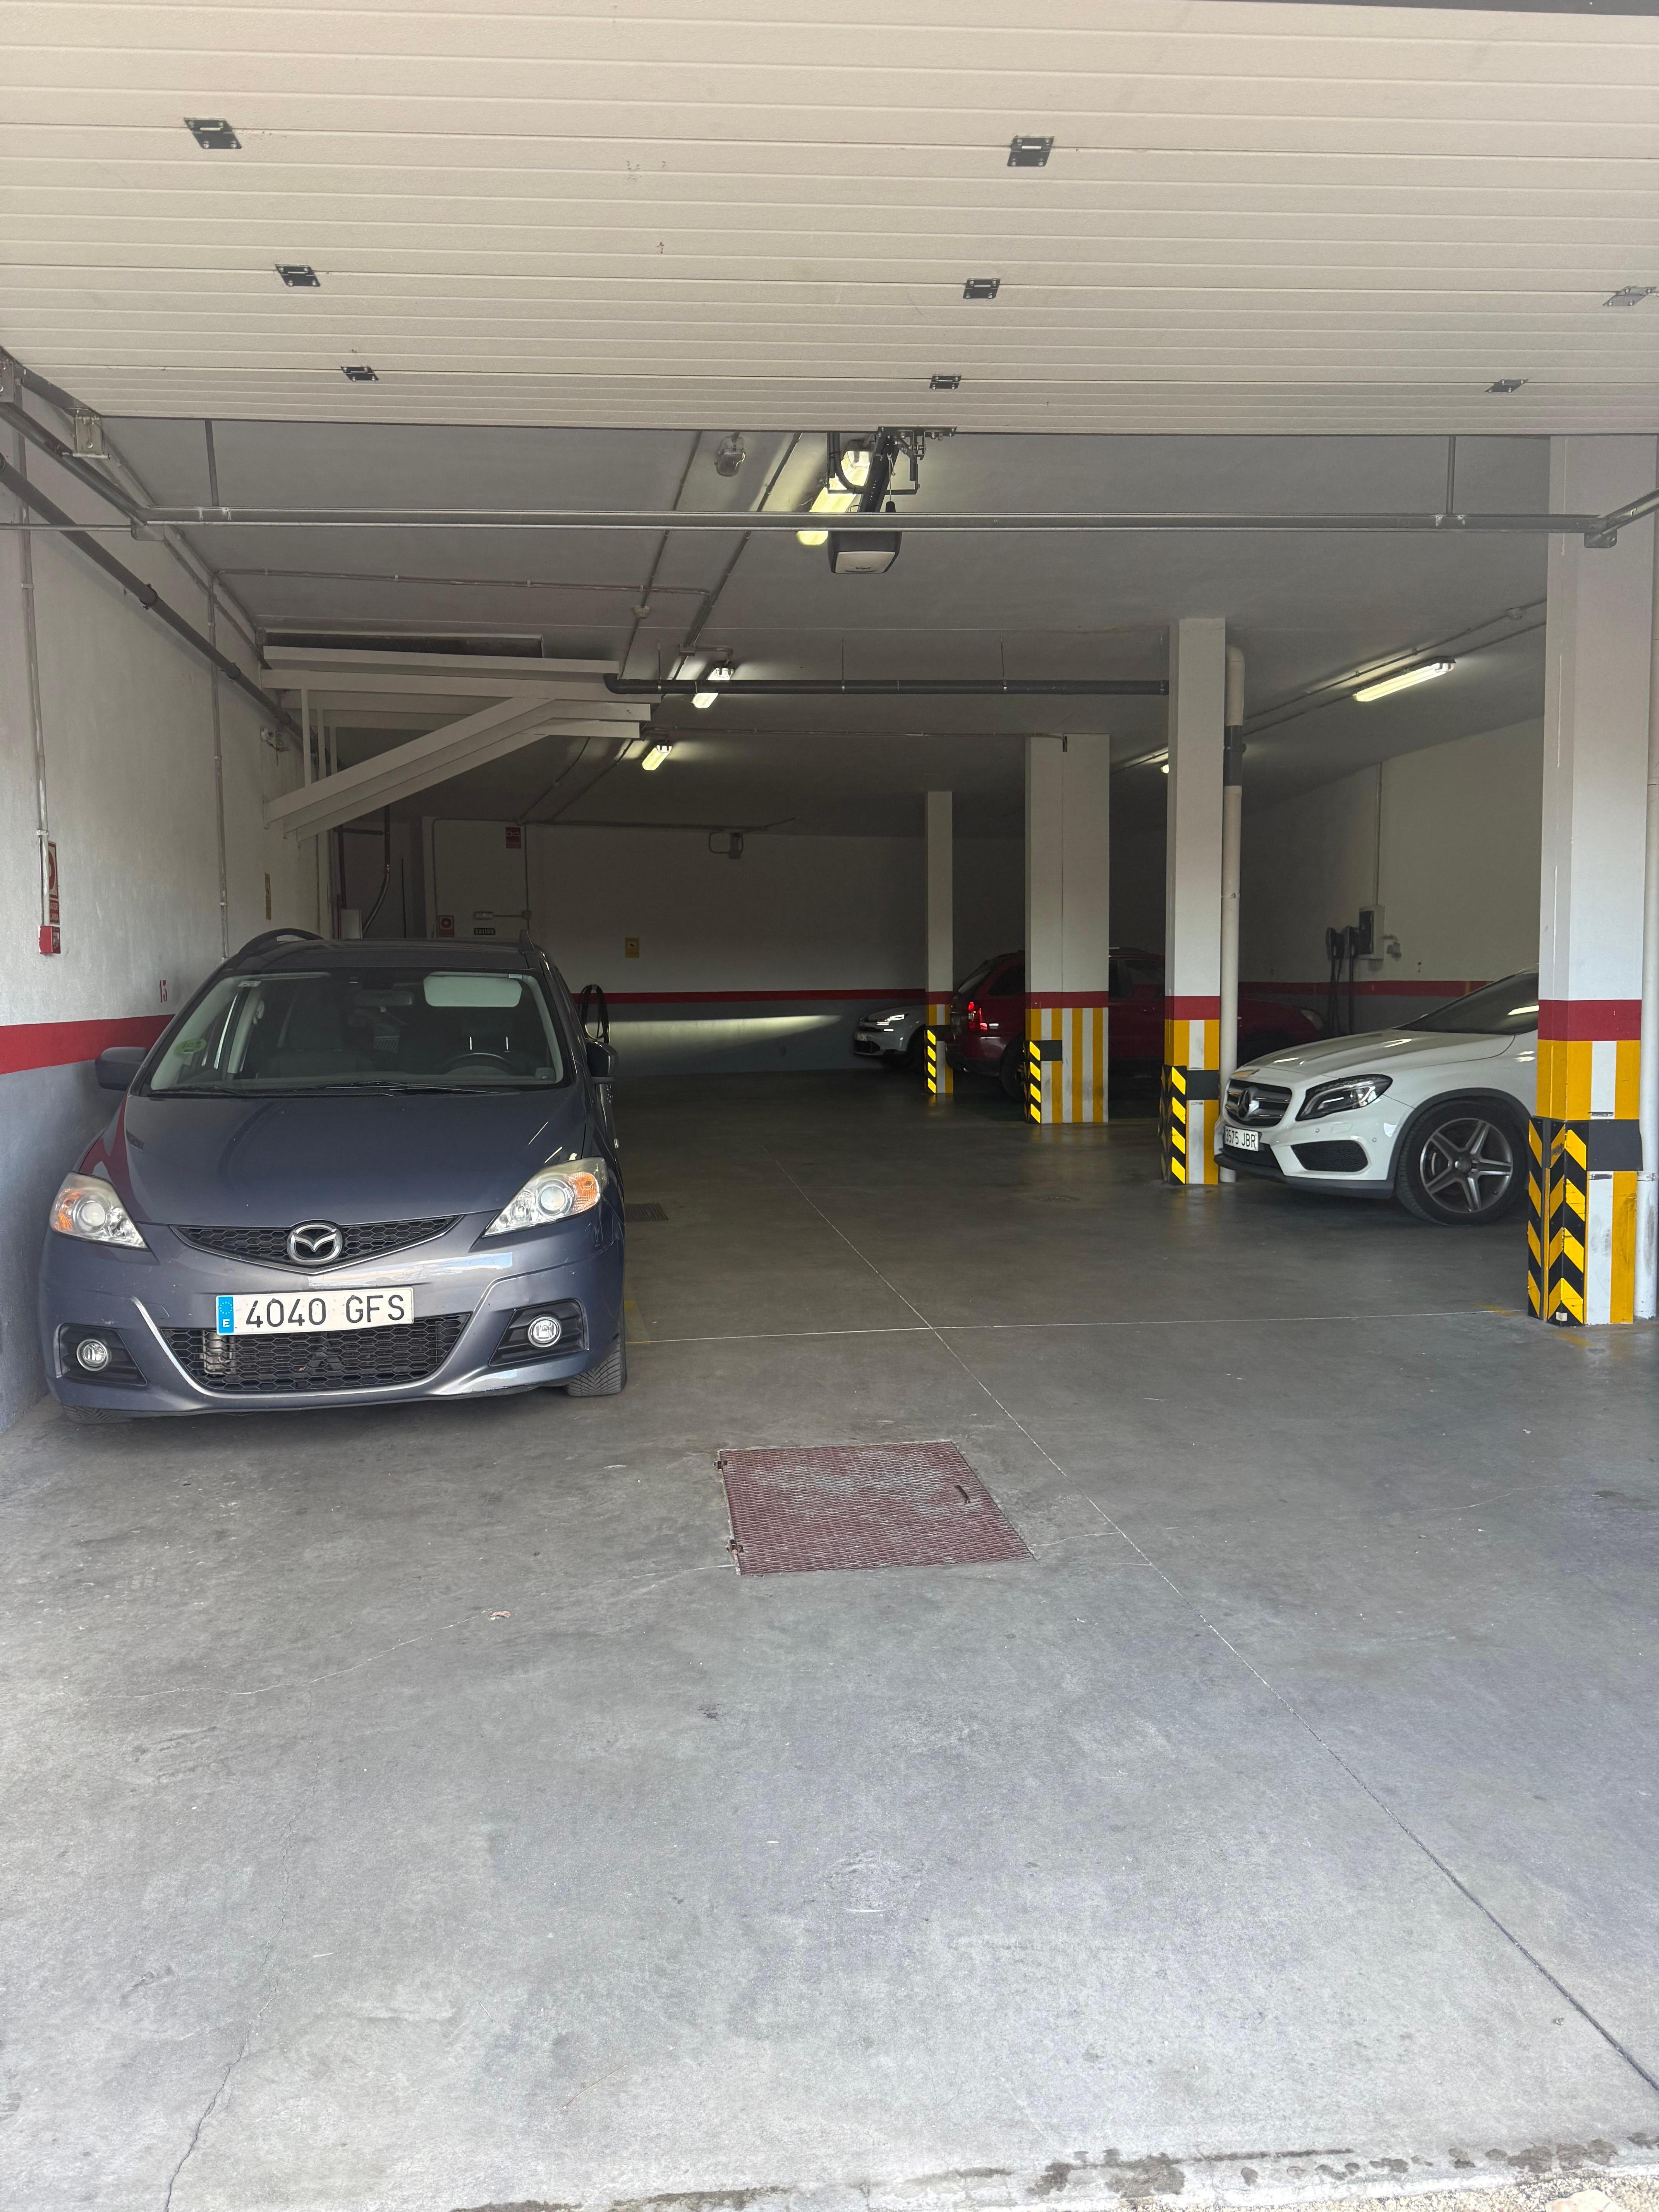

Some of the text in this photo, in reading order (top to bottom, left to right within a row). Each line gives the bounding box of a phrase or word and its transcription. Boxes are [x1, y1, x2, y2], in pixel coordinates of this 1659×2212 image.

[1242, 1133, 1256, 1150] JBR
[246, 1295, 405, 1328] 4040 GFS
[222, 1319, 230, 1328] E
